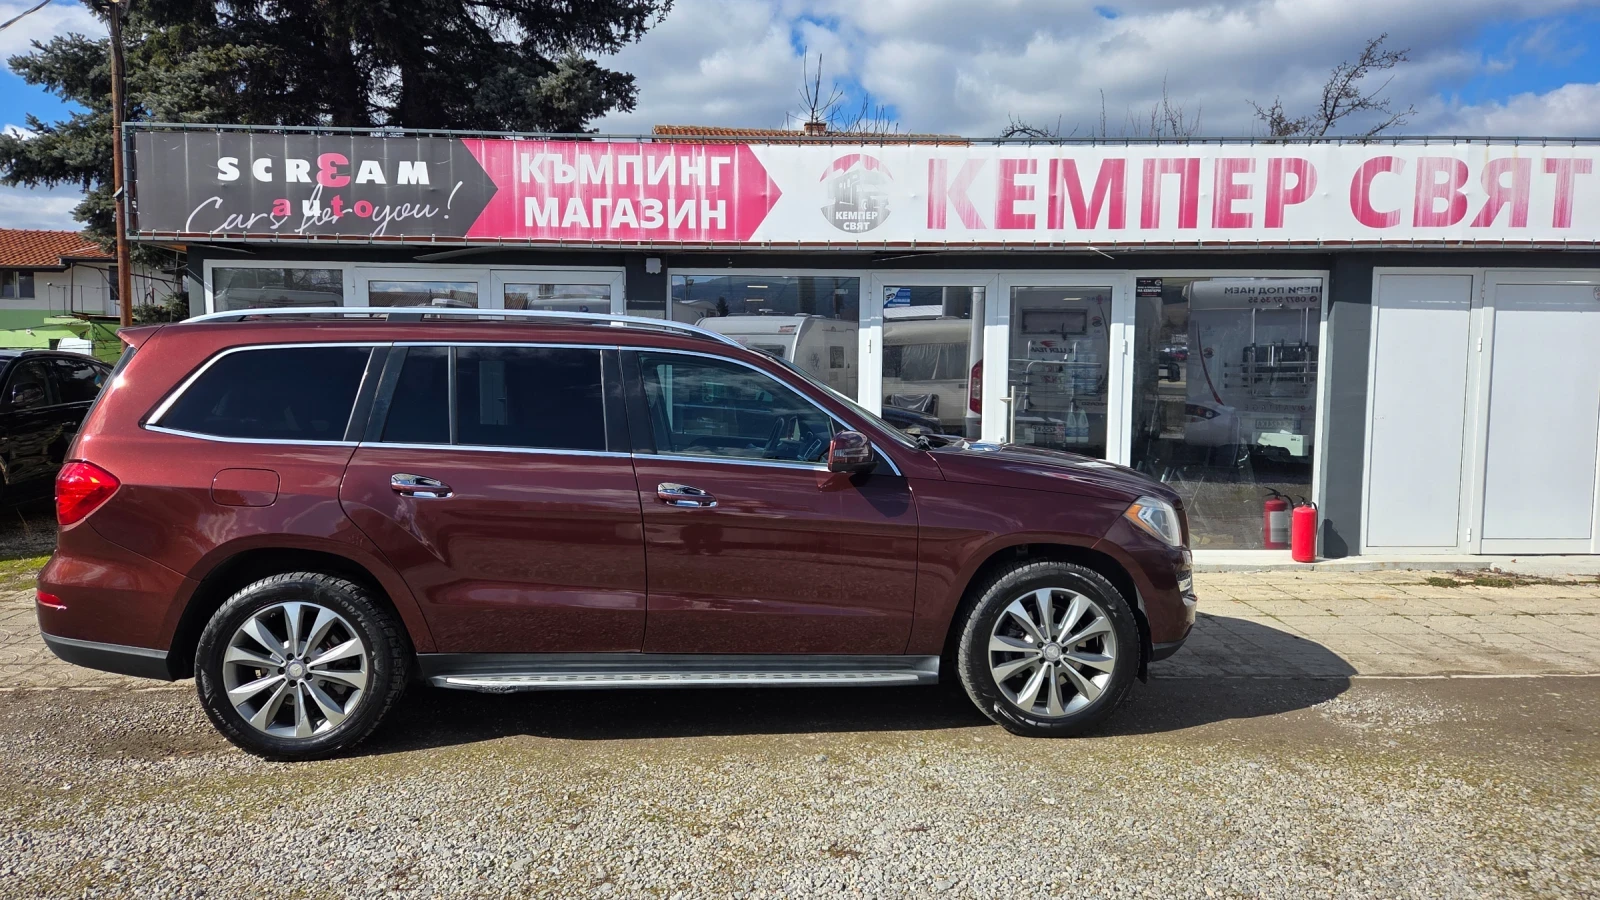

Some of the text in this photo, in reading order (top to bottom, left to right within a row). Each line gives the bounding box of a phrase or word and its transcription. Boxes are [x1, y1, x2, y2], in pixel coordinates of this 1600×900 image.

[217, 153, 430, 188] SCREAM
[520, 152, 731, 187] КЪМПИНГ
[185, 196, 288, 234] Cars
[372, 181, 463, 237] you!
[272, 195, 373, 218] auto
[927, 155, 1593, 230] КЕМПЕР СВЯТ
[524, 196, 727, 230] МАГАЗИН
[835, 211, 878, 220] КЕМПЕР
[843, 221, 870, 230] СВЯТ
